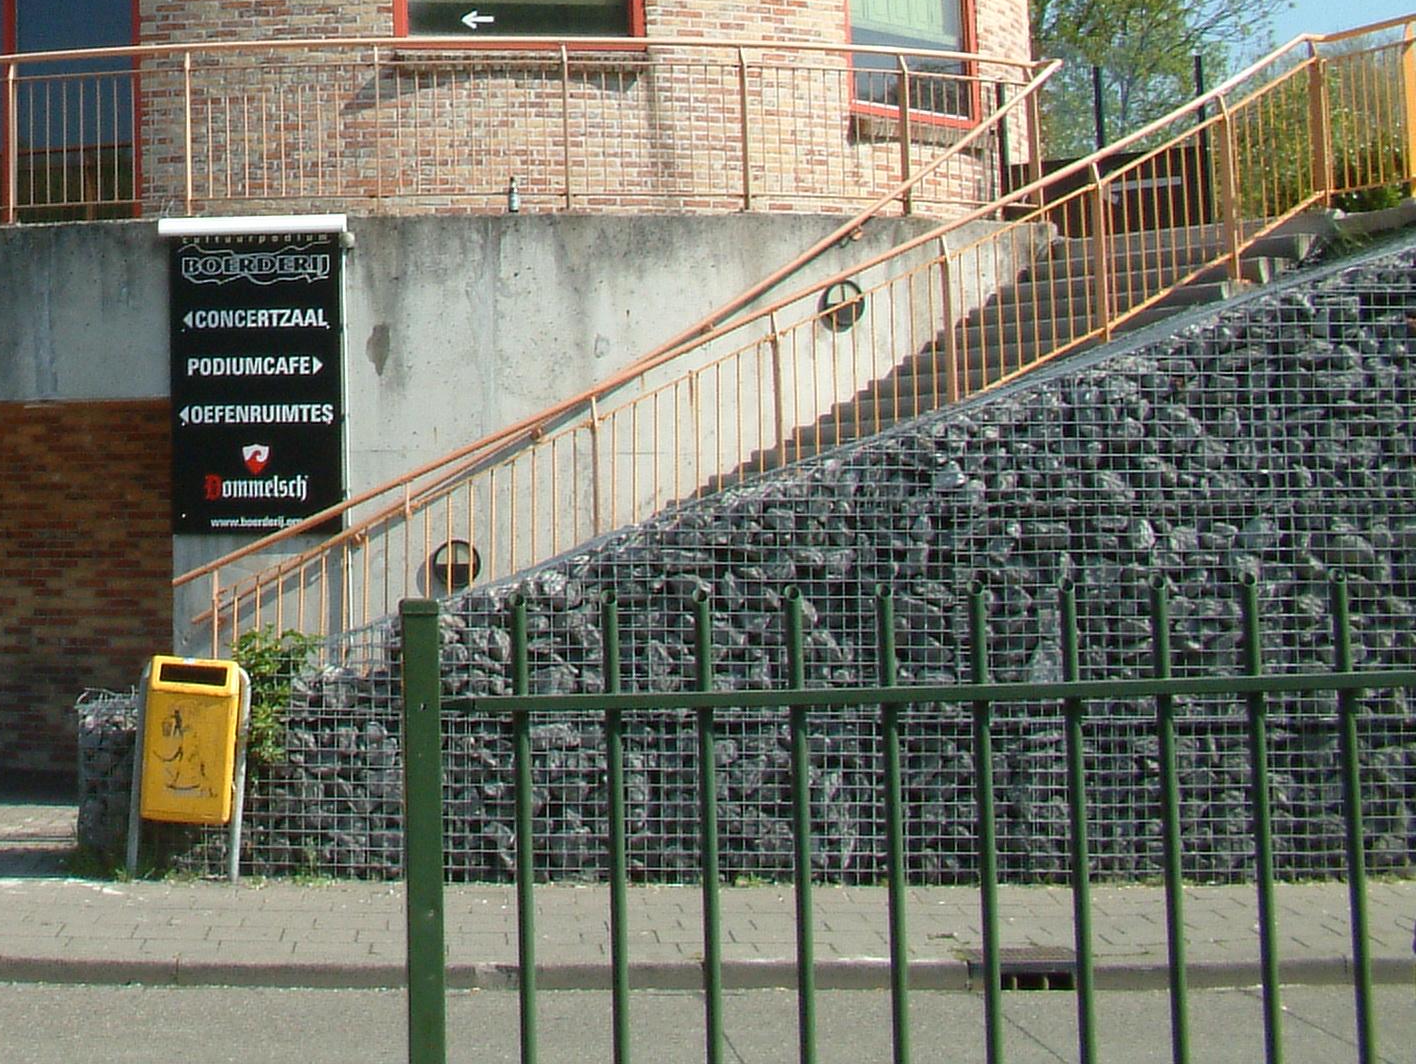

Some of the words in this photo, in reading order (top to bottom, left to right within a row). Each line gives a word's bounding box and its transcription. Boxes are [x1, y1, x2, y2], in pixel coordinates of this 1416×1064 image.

[182, 254, 331, 276] BOERDERIJ
[194, 309, 328, 328] CONCERTZAAL
[187, 356, 311, 376] PODIUMCAFE
[190, 404, 334, 423] OEFENRUIMTES
[204, 474, 308, 502] Dommelsch
